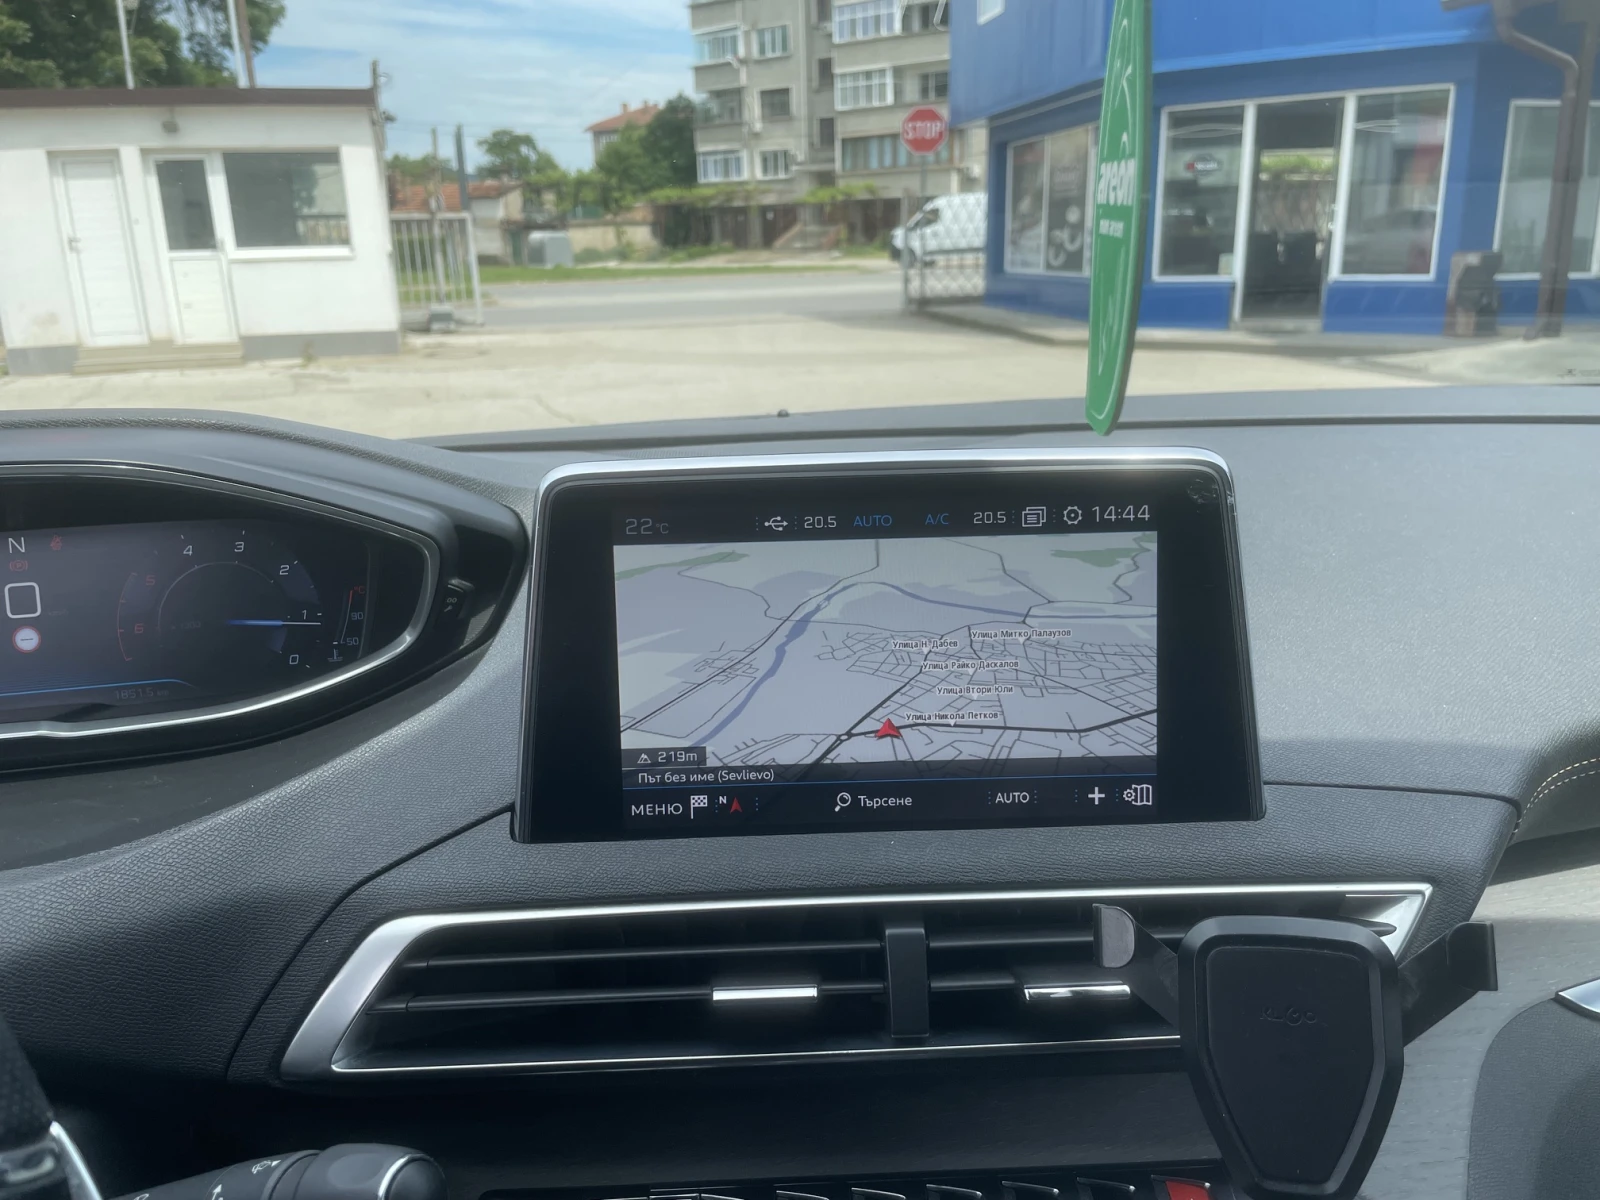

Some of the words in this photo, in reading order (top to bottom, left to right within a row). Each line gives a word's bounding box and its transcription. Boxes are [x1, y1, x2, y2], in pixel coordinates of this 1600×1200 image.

[904, 120, 944, 140] STOP
[1097, 158, 1135, 206] areon
[973, 511, 1007, 524] 20.5
[1092, 505, 1151, 522] 14:44
[804, 516, 837, 528] 20.5
[853, 515, 893, 527] AUTO
[925, 513, 949, 526] A/C
[8, 537, 26, 554] N
[183, 545, 193, 556] 4
[234, 542, 244, 552] 3
[280, 564, 290, 575] 2
[146, 575, 156, 586] 5
[350, 612, 364, 620] 90
[134, 624, 144, 634] 6
[972, 631, 998, 640] Улица
[1000, 630, 1028, 638] Митко
[1032, 629, 1072, 638] Палаузов
[346, 637, 359, 646] 50
[892, 641, 918, 649] Улица
[932, 640, 958, 648] Дабев
[290, 654, 299, 664] 0
[922, 662, 949, 670] Улица
[952, 660, 976, 669] Райко
[978, 660, 1018, 670] Даскалов
[937, 686, 963, 695] Улица
[966, 686, 992, 694] Втори
[906, 713, 932, 722] Улица
[968, 712, 998, 720] Петков
[658, 751, 698, 763] 219m
[638, 772, 662, 784] Път
[664, 771, 686, 782] без
[690, 772, 715, 782] име
[718, 769, 774, 782] (Sevlievo)
[719, 796, 727, 804] N
[858, 795, 912, 808] Търсене
[995, 792, 1030, 804] AUTO
[631, 803, 683, 816] МЕНЮ
